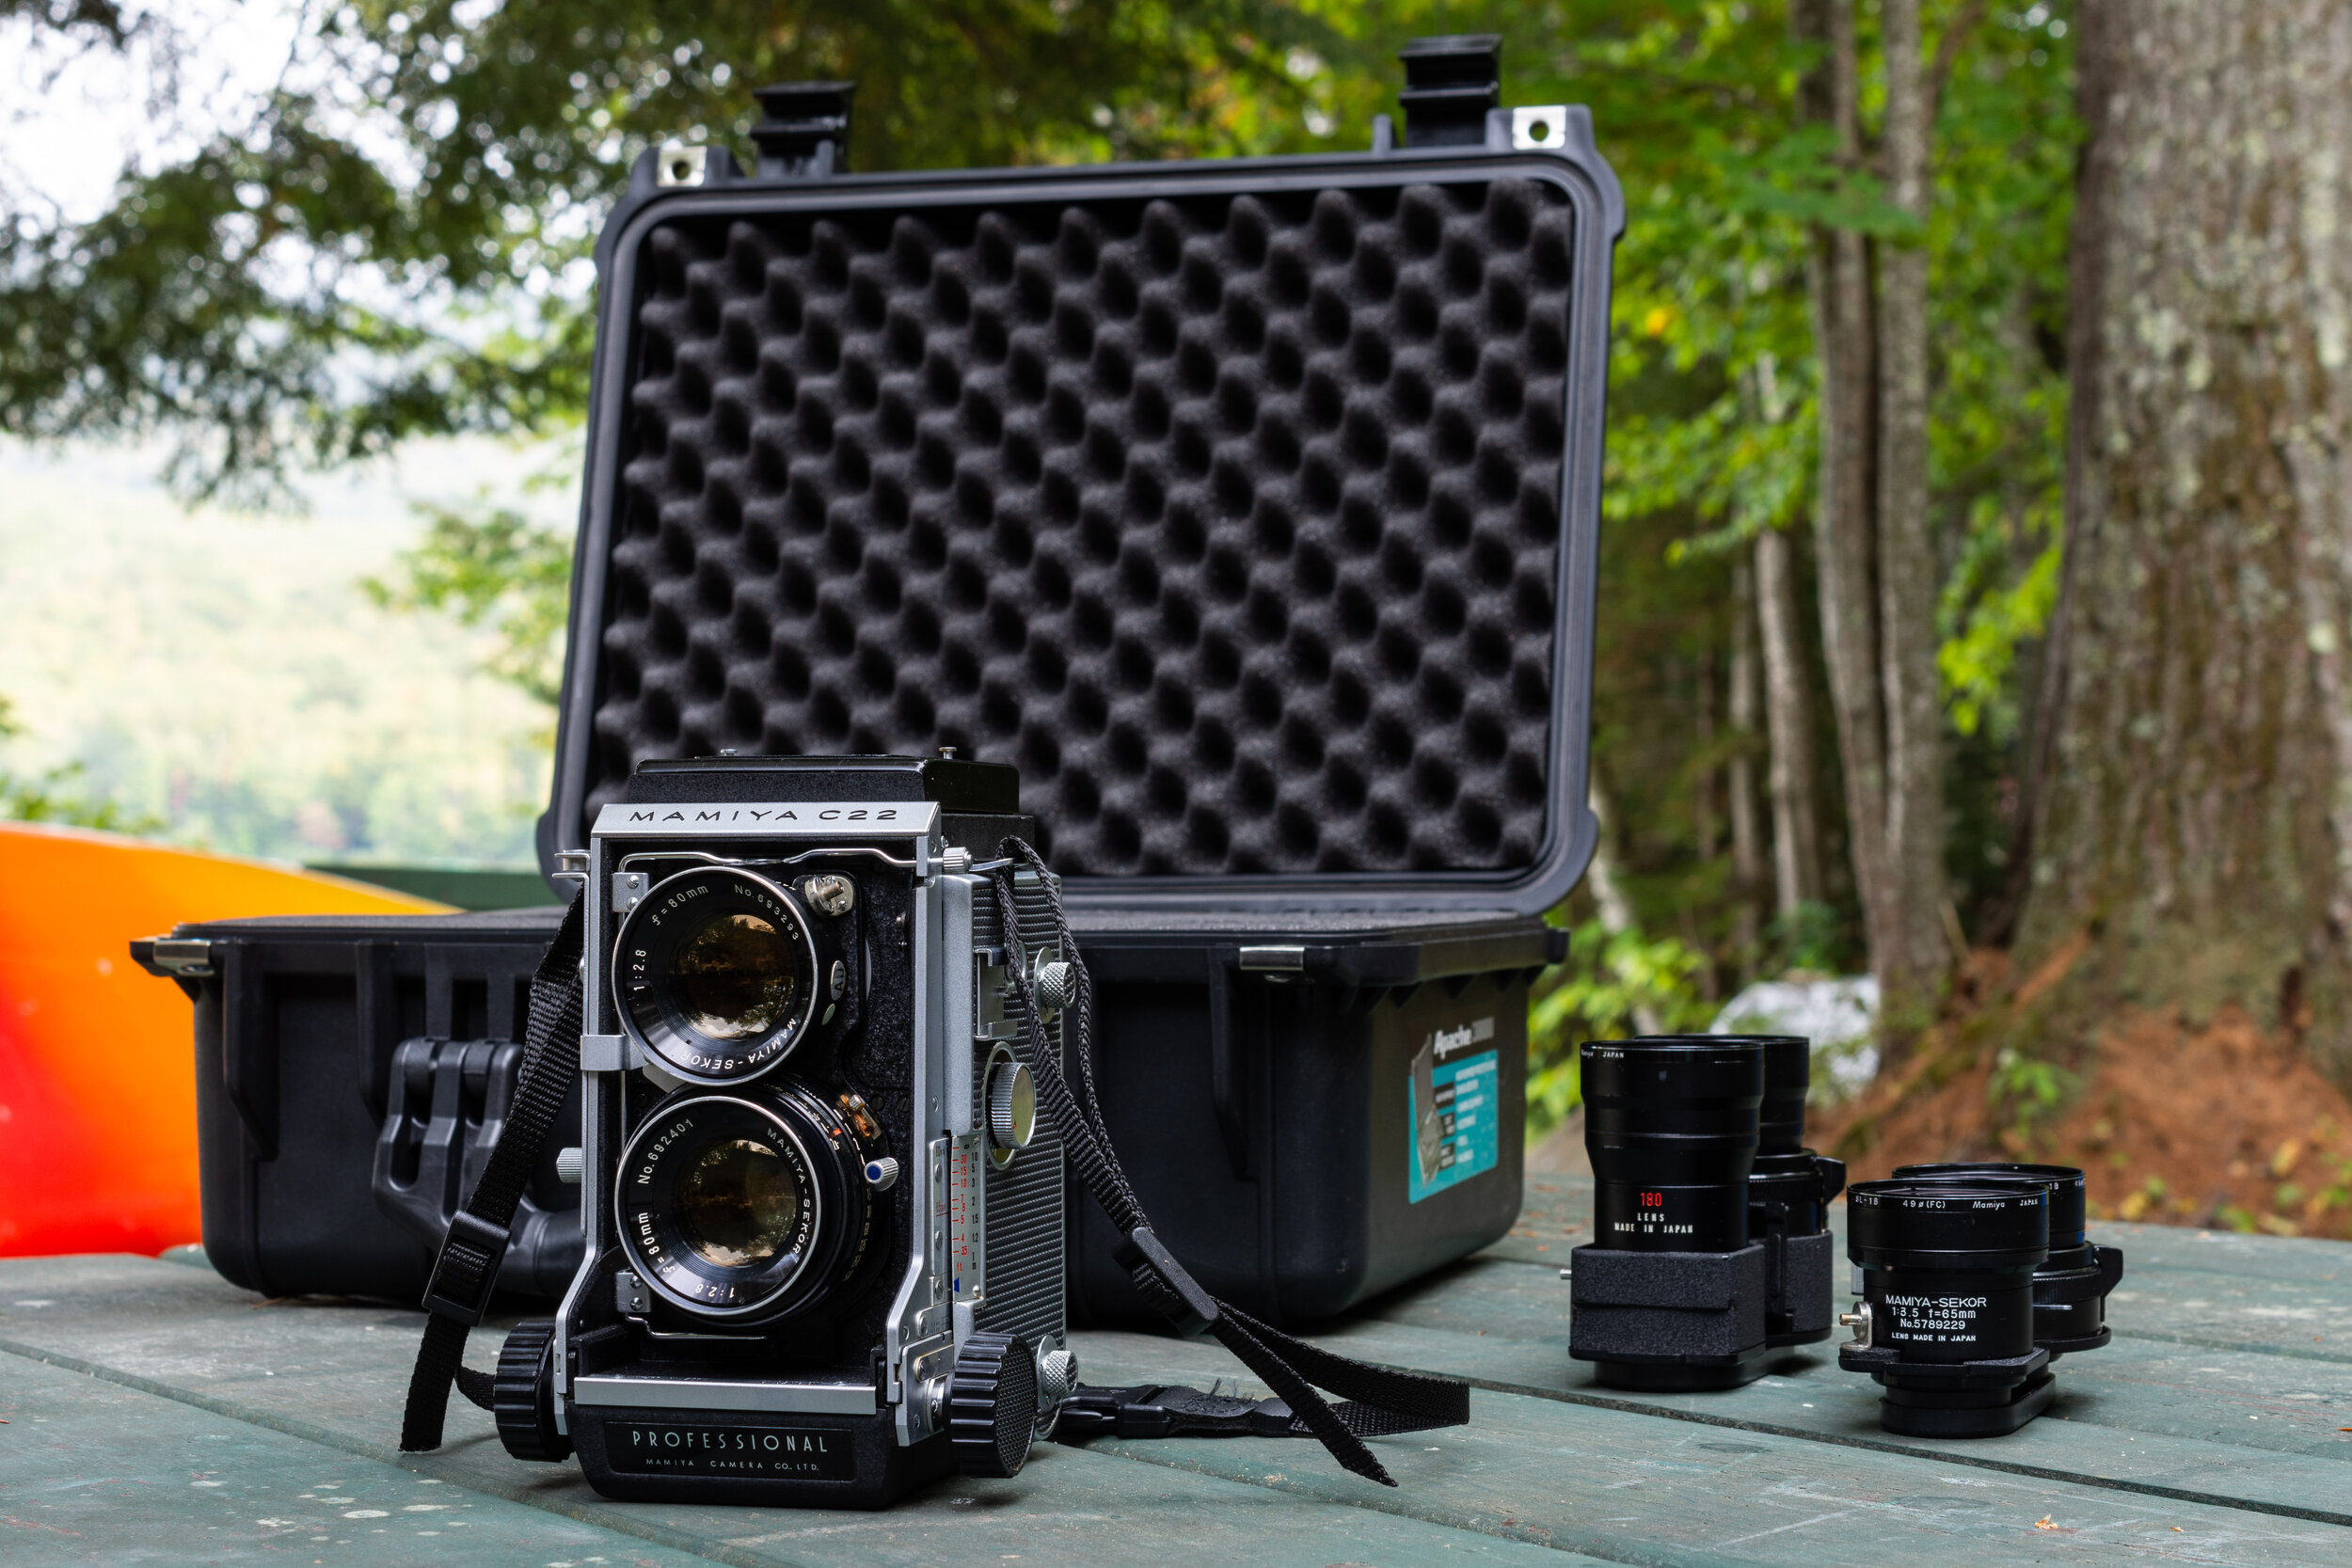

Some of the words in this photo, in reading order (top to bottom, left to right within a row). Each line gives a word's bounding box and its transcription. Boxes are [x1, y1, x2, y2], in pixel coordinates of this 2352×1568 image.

[628, 810, 799, 822] MAMIYA
[818, 809, 898, 821] C22
[1433, 1024, 1472, 1060] Apache
[637, 1118, 694, 1184] No.692401
[961, 1166, 967, 1177] 15
[767, 1128, 811, 1255] MAMIYA-SEKOR
[1640, 1193, 1662, 1207] 180
[1972, 1200, 2006, 1211] Mamiya
[2020, 1198, 2039, 1207] JAPAN
[1637, 1212, 1664, 1222] LENS
[1614, 1223, 1635, 1232] MADE
[1644, 1225, 1654, 1233] IN
[1663, 1225, 1693, 1233] JAPAN
[1885, 1294, 1987, 1307] MAMIYA-SEKOR
[1892, 1307, 1919, 1318] 1:3.5
[1899, 1318, 1966, 1330] No.5789229
[1891, 1332, 1909, 1340] LENS
[632, 1431, 828, 1453] PROFESSIONAL
[710, 1460, 763, 1469] CAMERA
